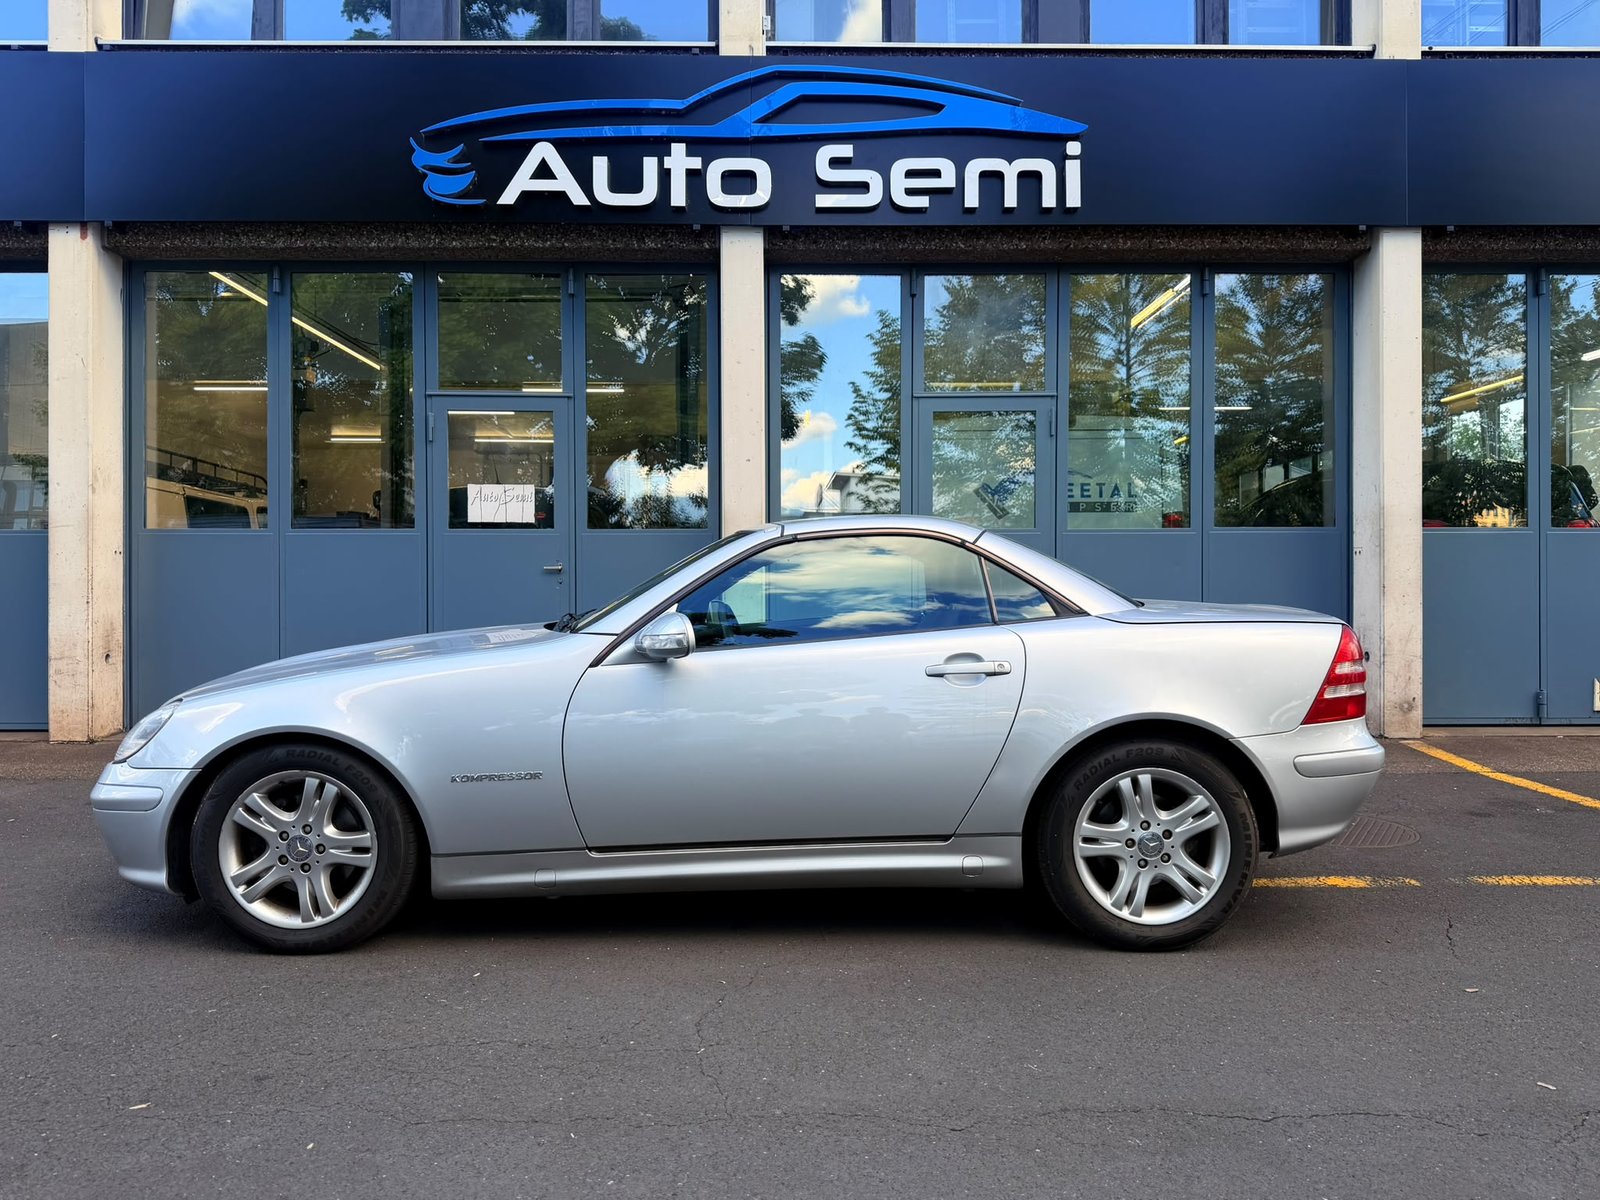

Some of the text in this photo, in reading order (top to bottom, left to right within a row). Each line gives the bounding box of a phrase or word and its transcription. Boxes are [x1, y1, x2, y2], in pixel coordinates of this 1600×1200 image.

[497, 141, 1082, 208] Auto Semi
[285, 749, 340, 767] RADIAL
[450, 771, 543, 783] KOMPRESSOR
[1073, 754, 1121, 791] RADIAL
